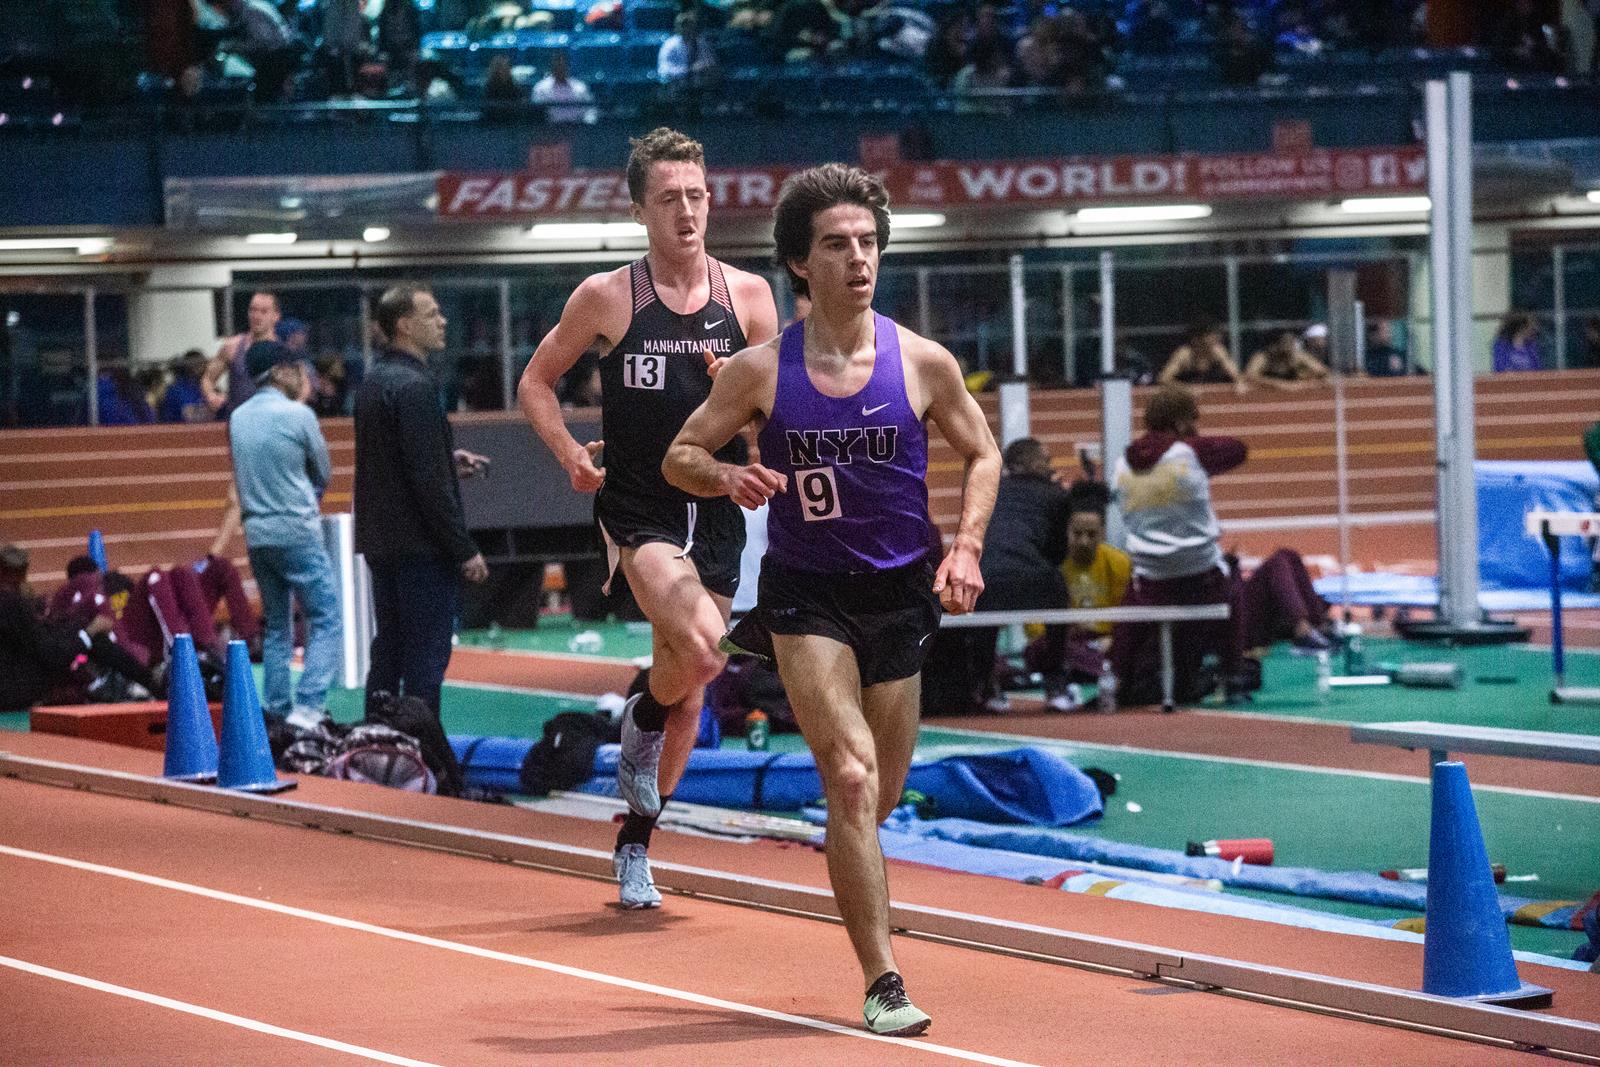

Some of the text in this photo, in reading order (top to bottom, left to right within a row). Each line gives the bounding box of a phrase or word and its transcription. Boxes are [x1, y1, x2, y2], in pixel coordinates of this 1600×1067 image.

[449, 176, 631, 212] FASTES
[957, 162, 1186, 200] WORLD!
[643, 338, 731, 354] MANHATTANVILLE
[626, 355, 658, 388] 13
[786, 425, 898, 466] NYU
[803, 471, 836, 517] 9
